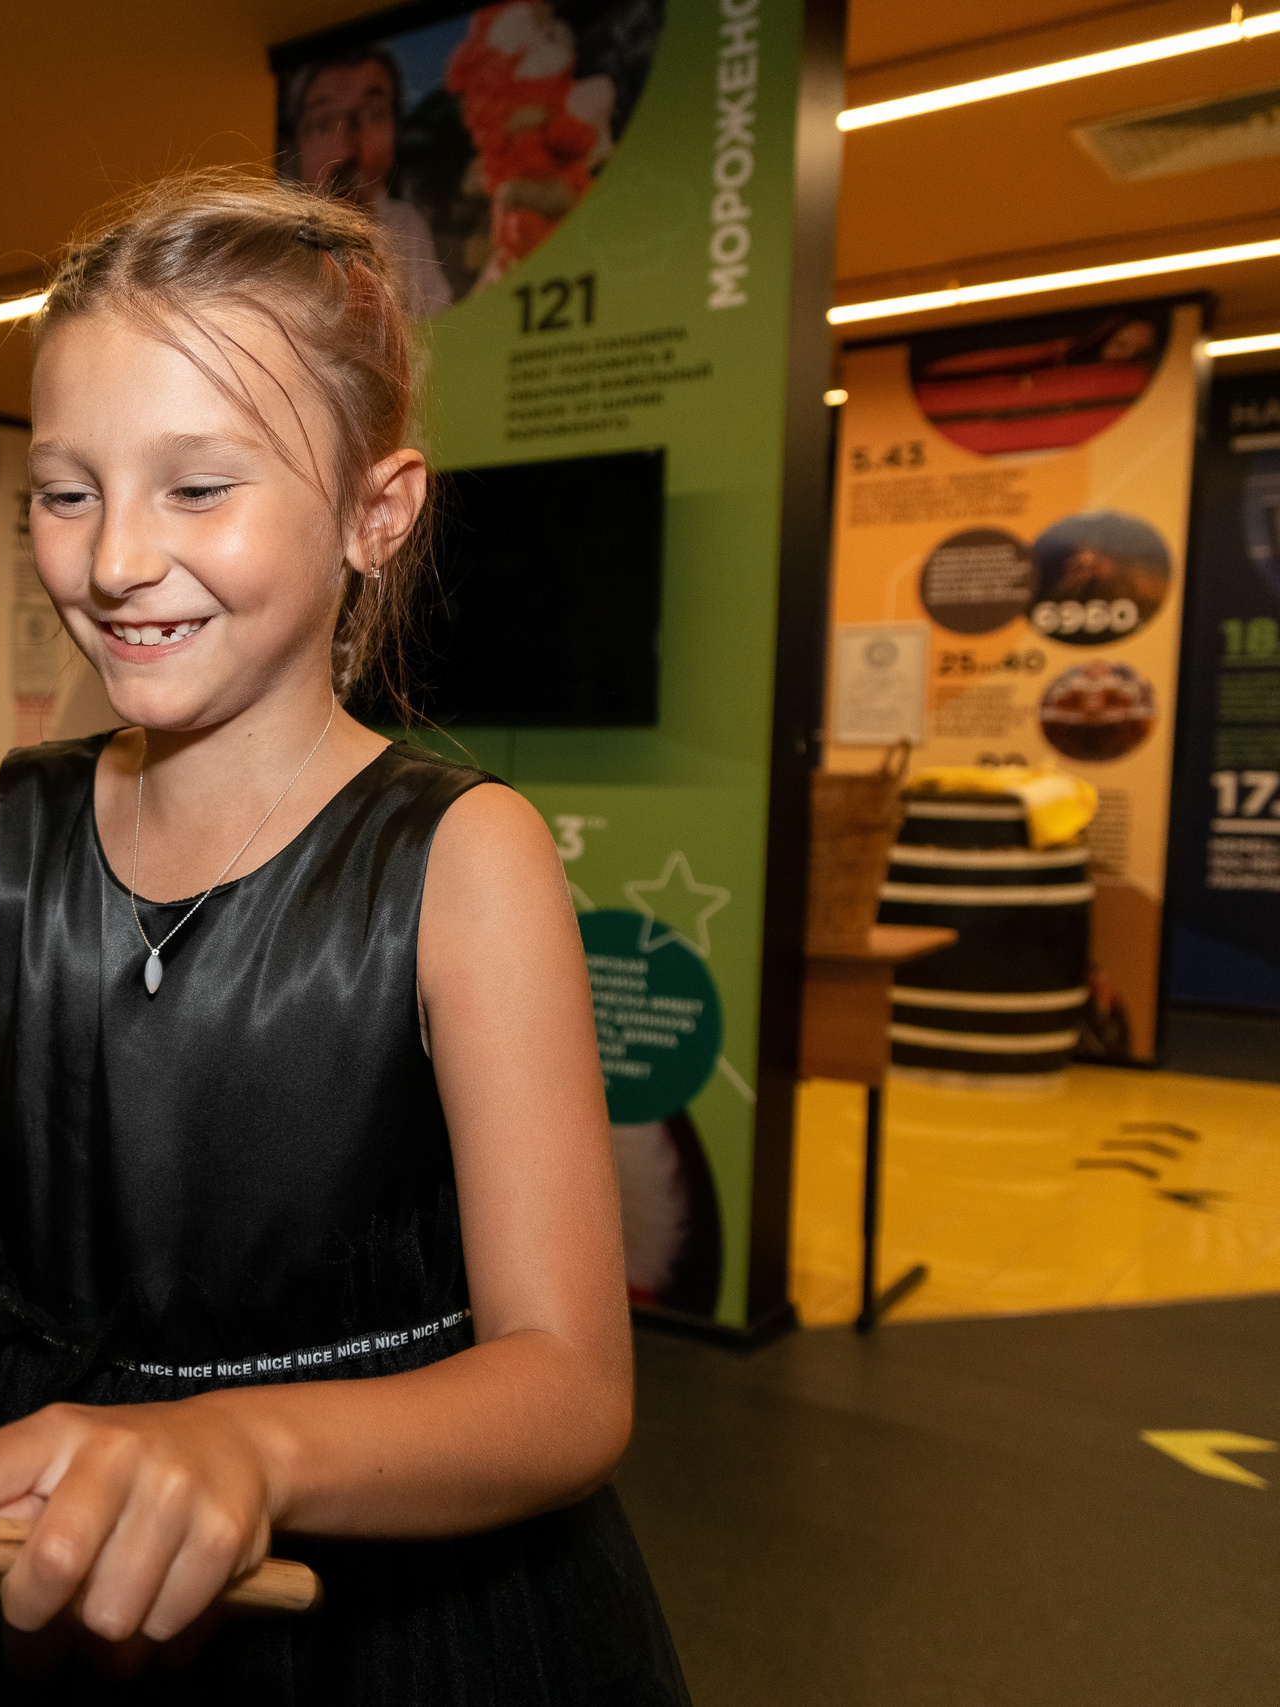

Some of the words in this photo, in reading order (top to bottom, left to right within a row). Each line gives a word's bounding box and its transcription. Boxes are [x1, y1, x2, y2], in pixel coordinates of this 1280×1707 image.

[514, 271, 596, 334] 121
[140, 1363, 173, 1376] NICE
[178, 1366, 212, 1378] NICE
[217, 1363, 252, 1376] NICE
[257, 1356, 292, 1372] NICE
[297, 1351, 333, 1366] NICE
[337, 1340, 371, 1358] NICE
[375, 1332, 409, 1349] NICE
[412, 1322, 440, 1341] NICE
[442, 1311, 463, 1329] NICE
